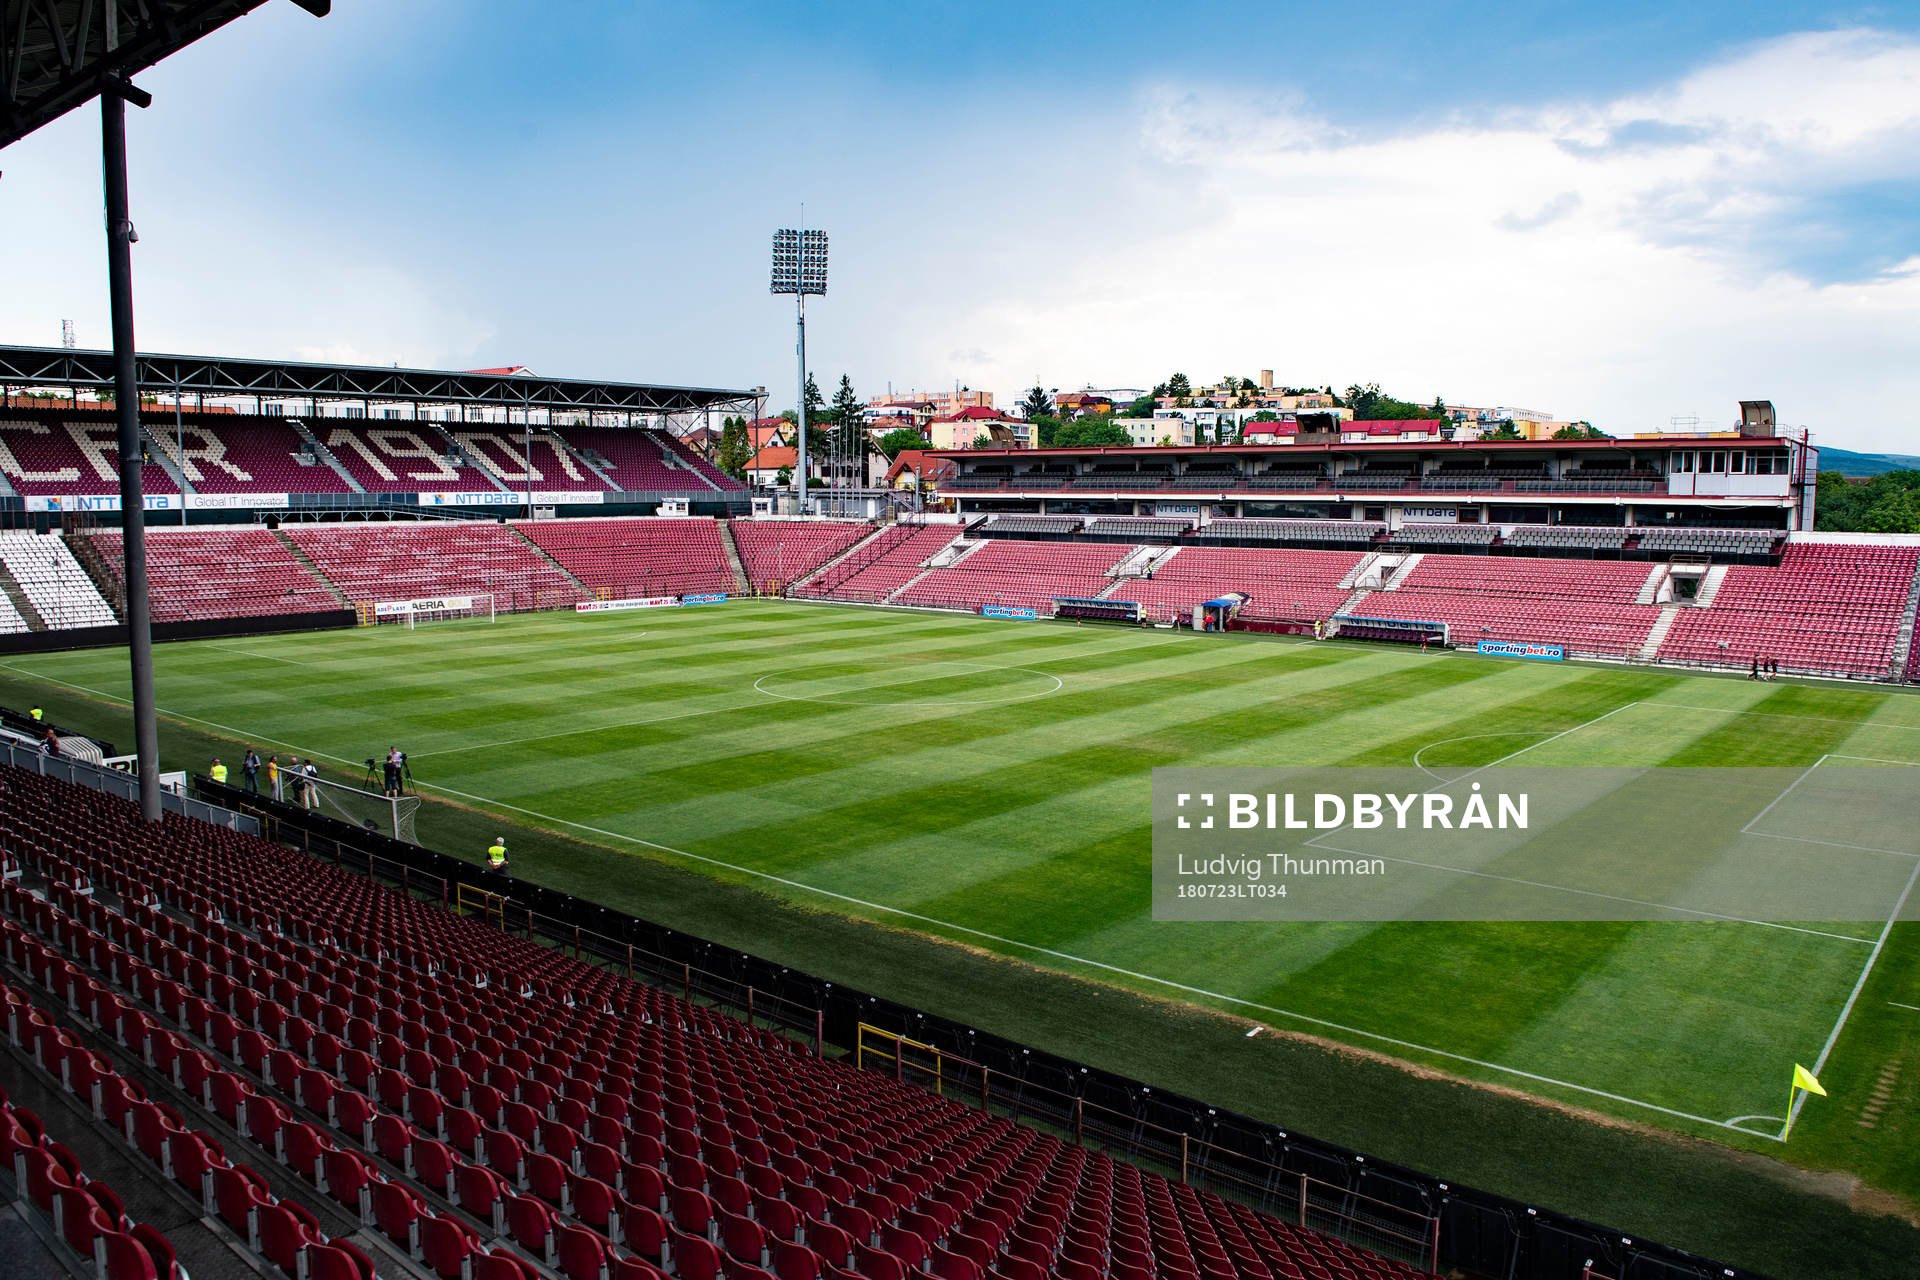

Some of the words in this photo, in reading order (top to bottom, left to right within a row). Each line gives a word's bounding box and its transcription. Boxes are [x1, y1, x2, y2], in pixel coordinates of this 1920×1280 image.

[327, 428, 585, 482] 1907
[80, 497, 116, 510] NTT
[194, 496, 226, 507] Global
[229, 496, 238, 506] IT
[241, 496, 285, 507] Innovator
[455, 494, 482, 504] NTT
[537, 494, 559, 503] Global
[1156, 504, 1175, 513] NTT
[1403, 508, 1426, 517] NTT
[684, 595, 725, 604] portingbet.ro
[412, 600, 445, 610] AERIA
[985, 607, 1033, 617] sportingbet.ro
[1482, 644, 1560, 657] sportingbet.ro
